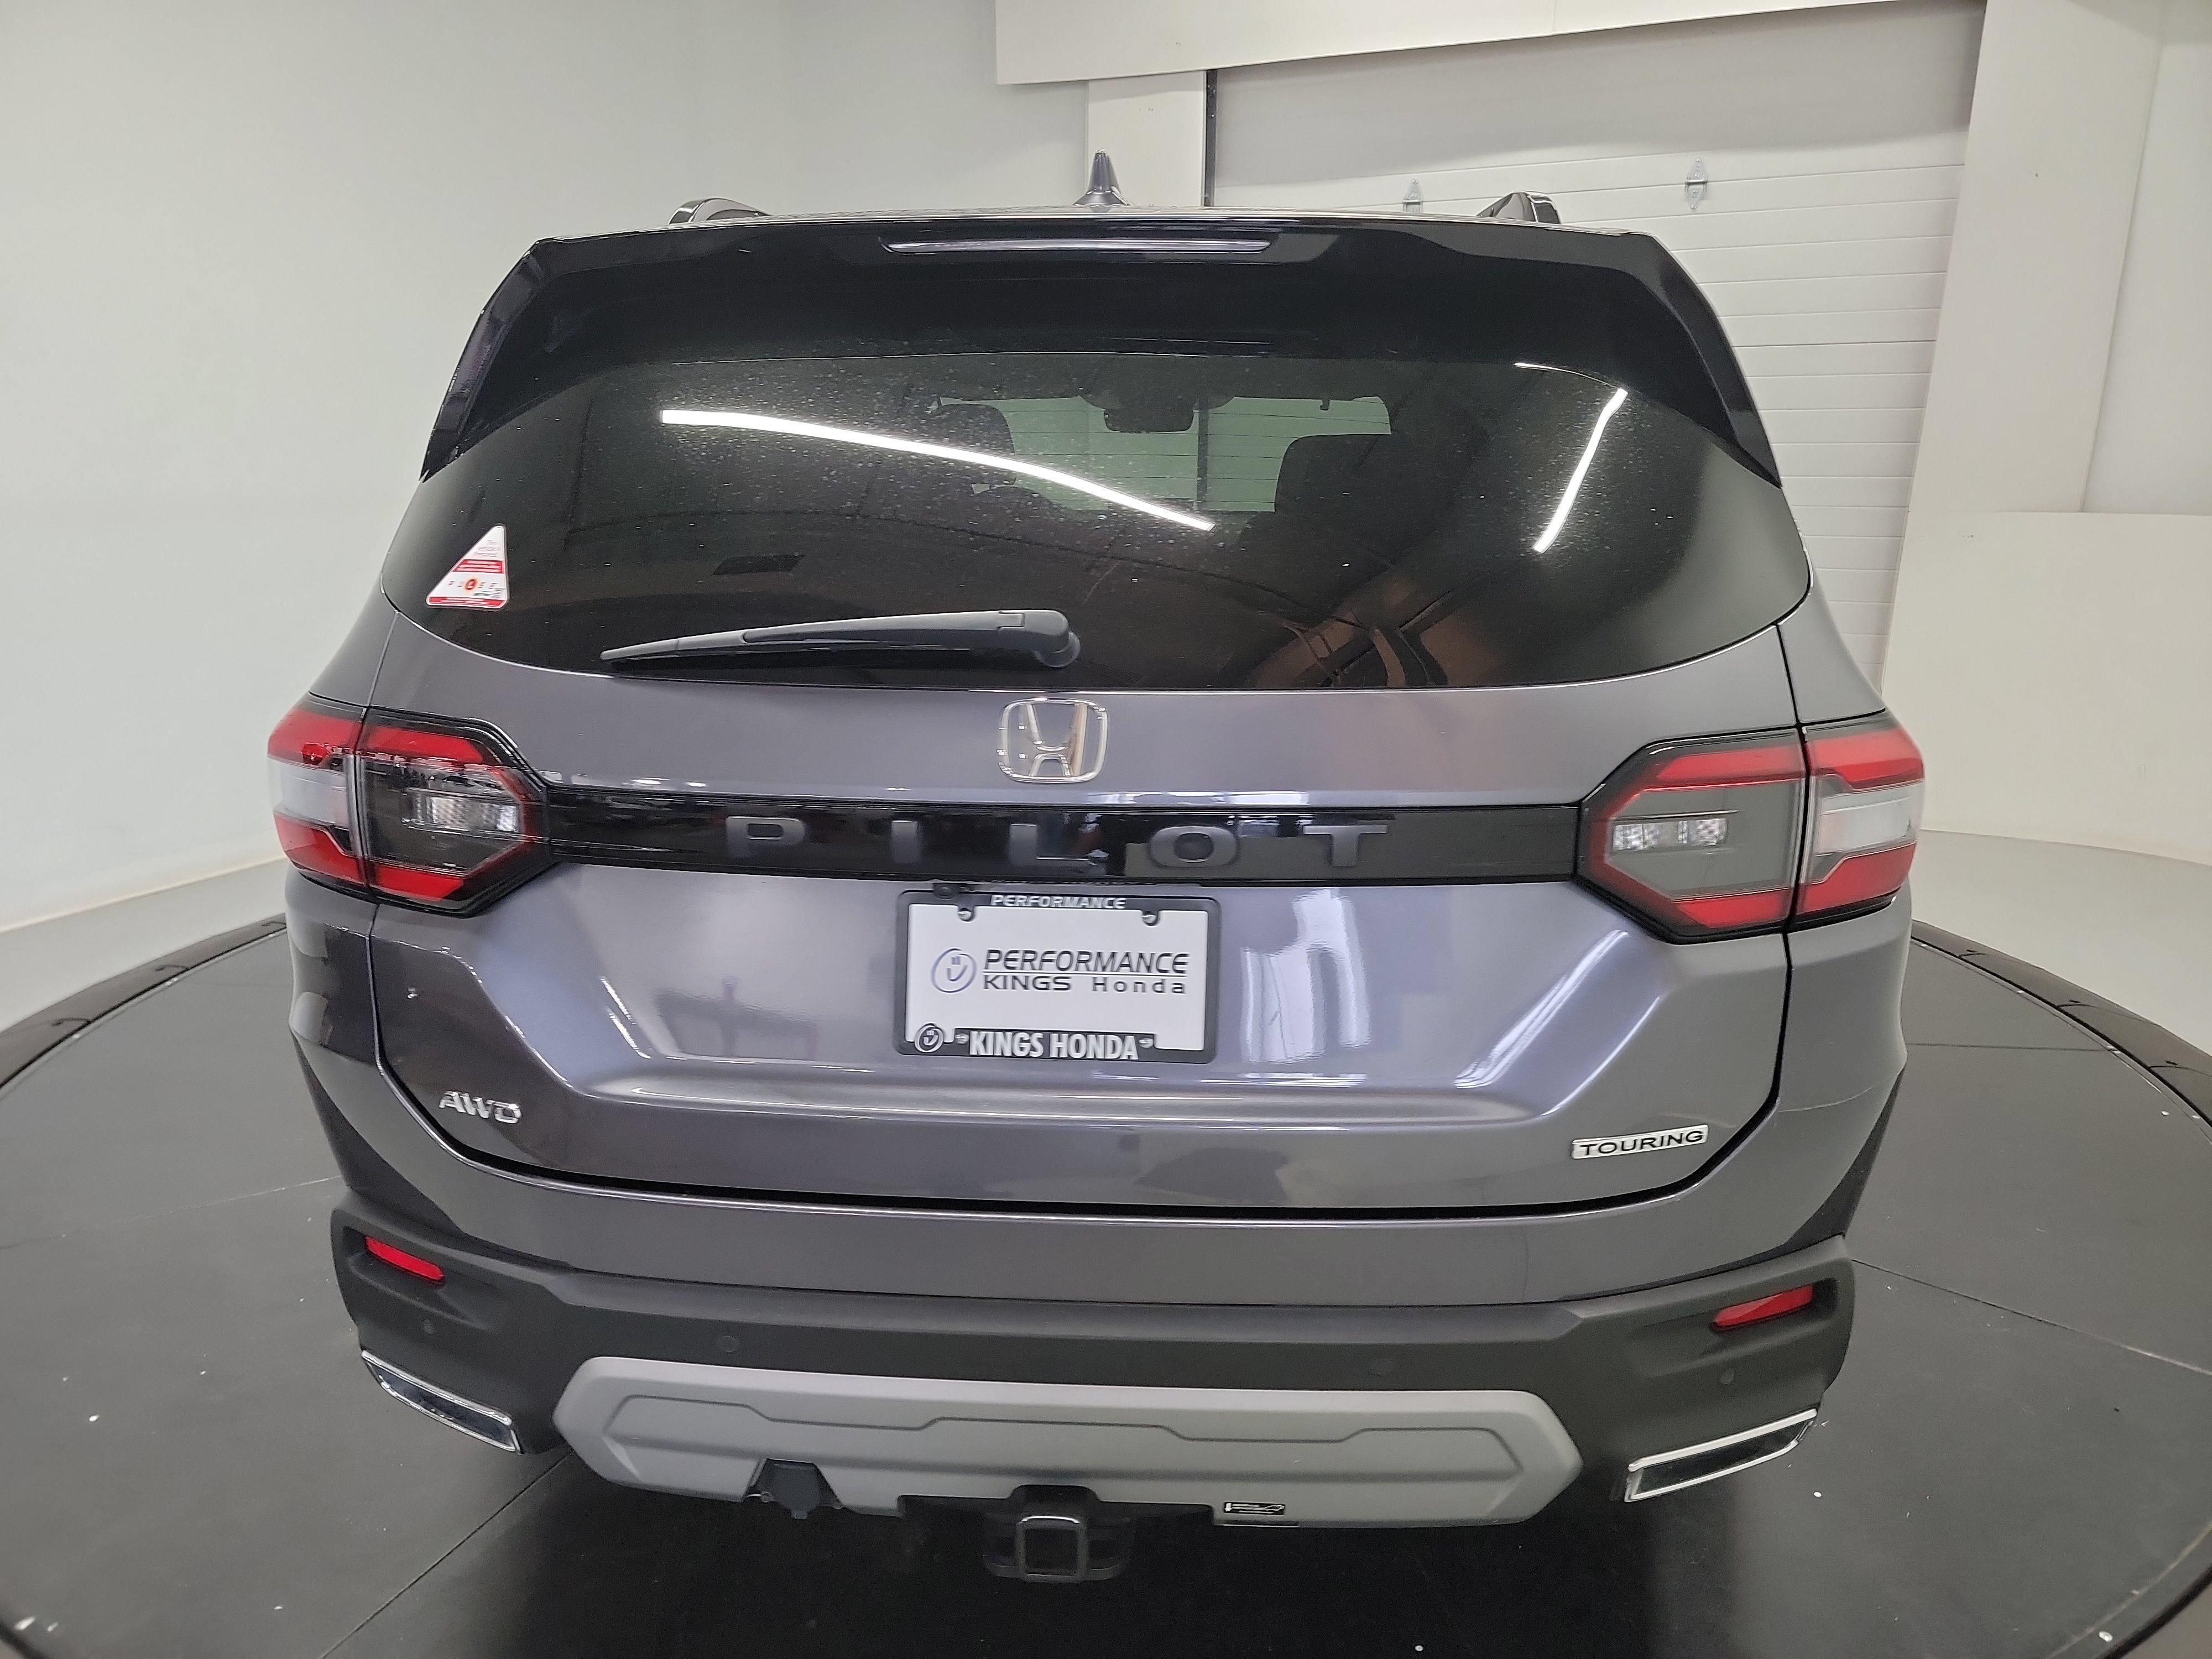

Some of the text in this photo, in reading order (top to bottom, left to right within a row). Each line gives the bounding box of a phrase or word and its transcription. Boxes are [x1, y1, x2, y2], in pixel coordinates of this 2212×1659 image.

[726, 816, 1388, 868] PILOT
[990, 894, 1126, 910] PERFORMANCE
[984, 949, 1190, 974] PERFORMANCE
[983, 974, 1186, 994] KINGS Honda
[969, 1030, 1139, 1061] KINGS HONDA
[439, 1090, 522, 1124] AWD
[1580, 1130, 1704, 1156] TOURING
